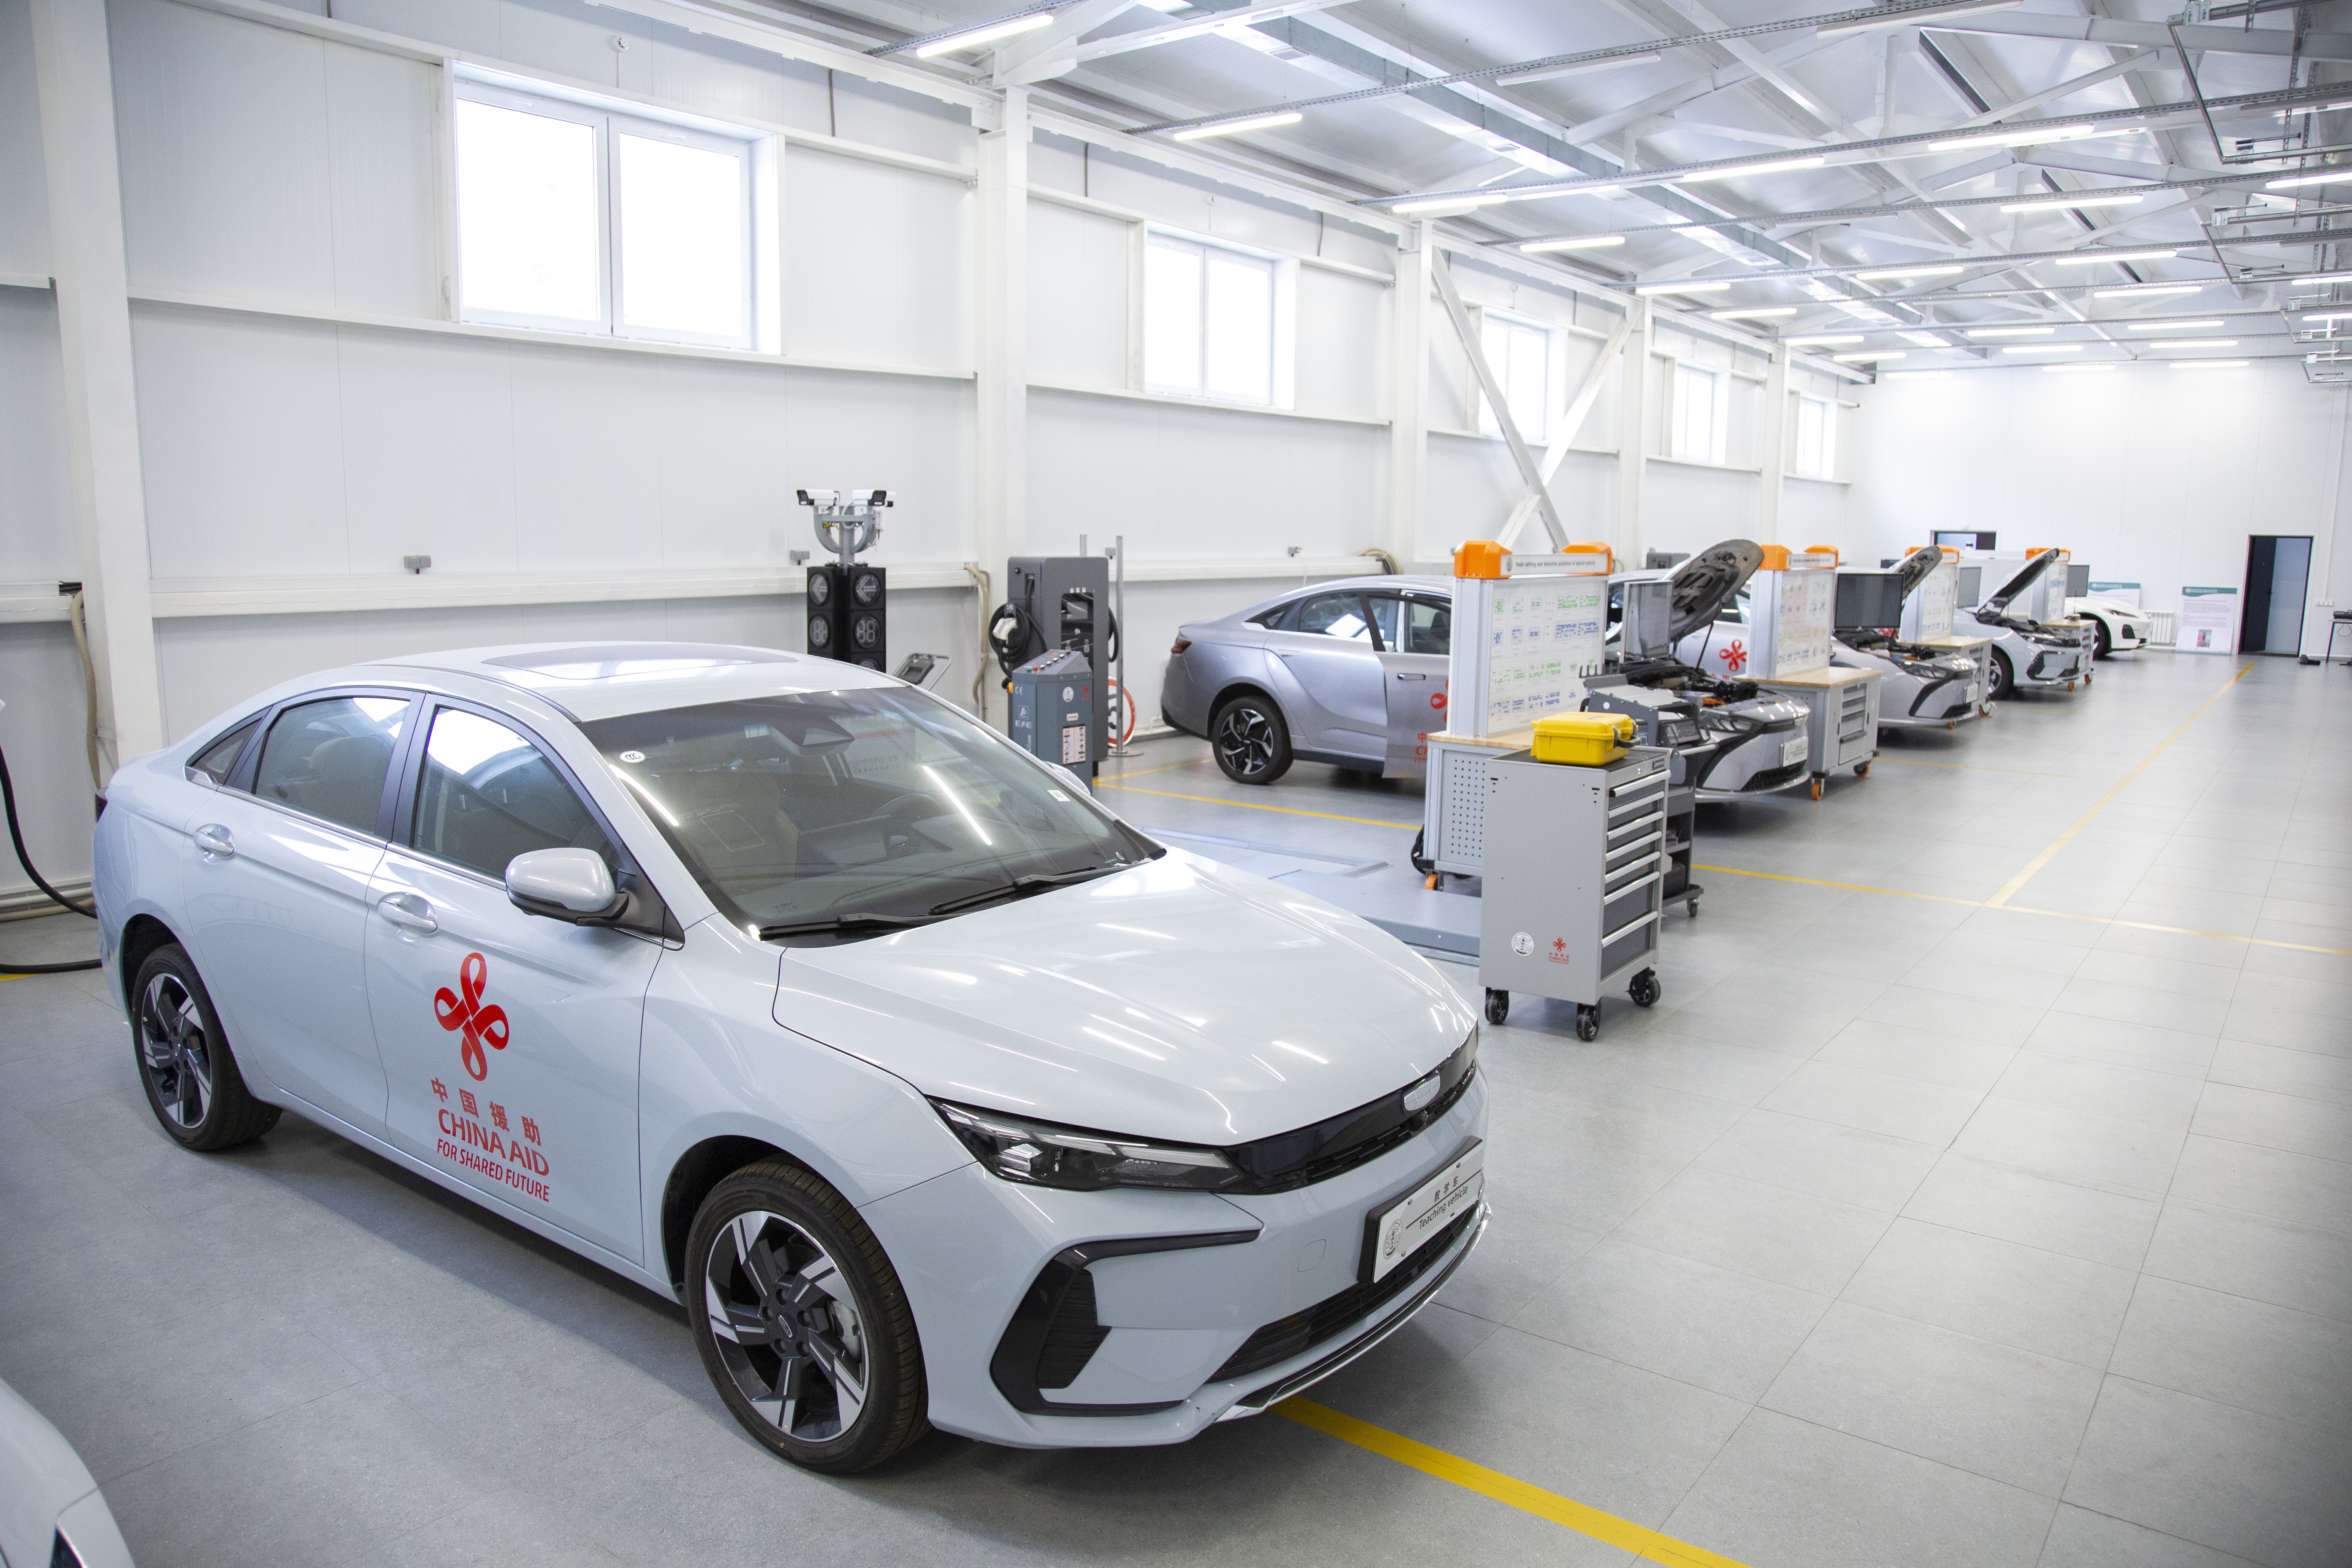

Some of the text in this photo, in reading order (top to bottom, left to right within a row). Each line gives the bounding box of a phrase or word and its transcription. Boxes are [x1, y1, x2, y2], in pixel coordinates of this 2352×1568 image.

[431, 1077, 541, 1146] 中国援助
[438, 1109, 549, 1176] CHINA AID
[437, 1138, 550, 1202] FOR SHARED FUTURE
[1434, 1176, 1458, 1203] 教学车
[1419, 1185, 1468, 1229] Teaching vehicle
